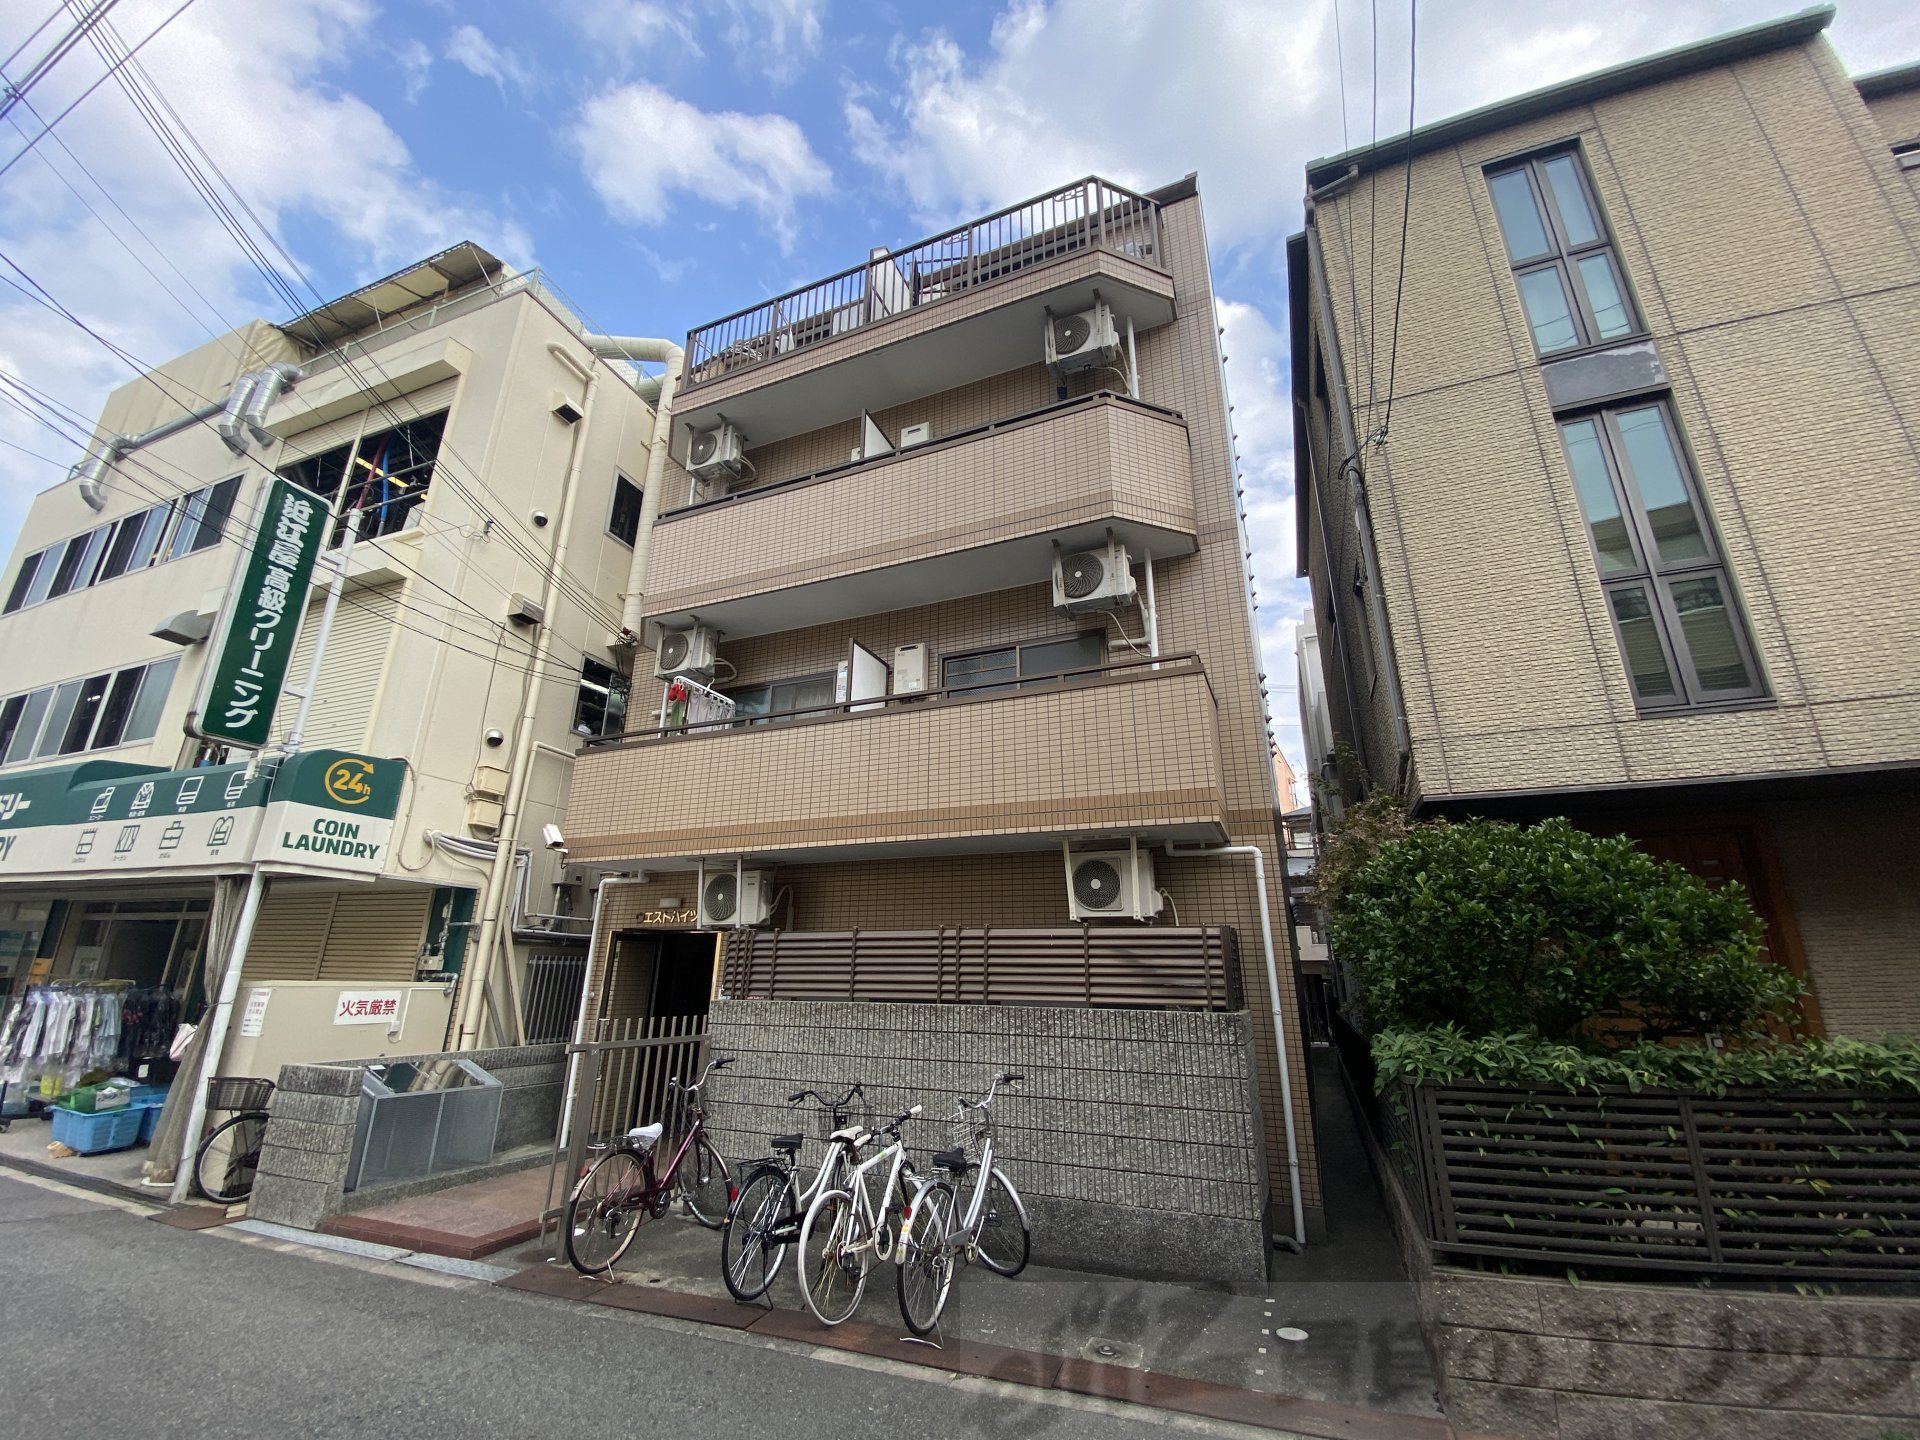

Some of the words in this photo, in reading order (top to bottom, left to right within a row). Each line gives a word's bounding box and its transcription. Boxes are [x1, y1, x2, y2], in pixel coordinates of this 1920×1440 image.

[333, 769, 371, 795] 24h
[313, 818, 360, 839] COIN
[282, 832, 380, 859] LAUNDRY
[339, 999, 396, 1016] 火気厳禁
